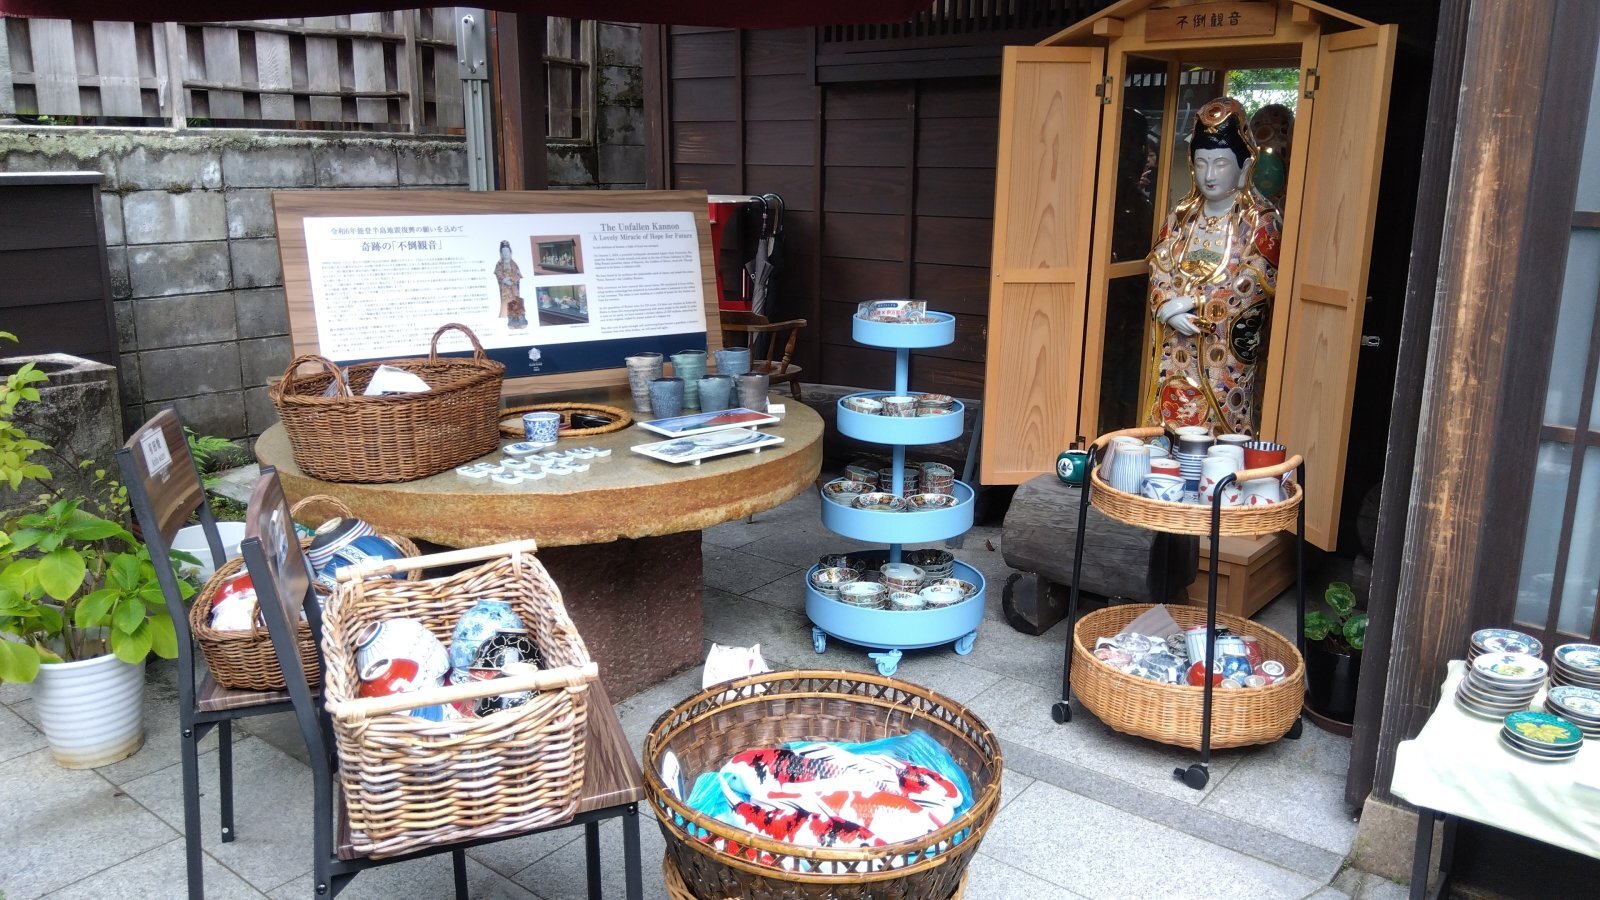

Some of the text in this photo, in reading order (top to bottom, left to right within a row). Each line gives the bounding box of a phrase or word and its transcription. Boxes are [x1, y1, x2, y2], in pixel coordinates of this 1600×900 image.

[1176, 12, 1242, 29] 不倒観音
[600, 222, 680, 232] The Unfallen Kannon
[599, 234, 618, 242] Lovely
[361, 239, 443, 252] 奇跡の「不倒観音」
